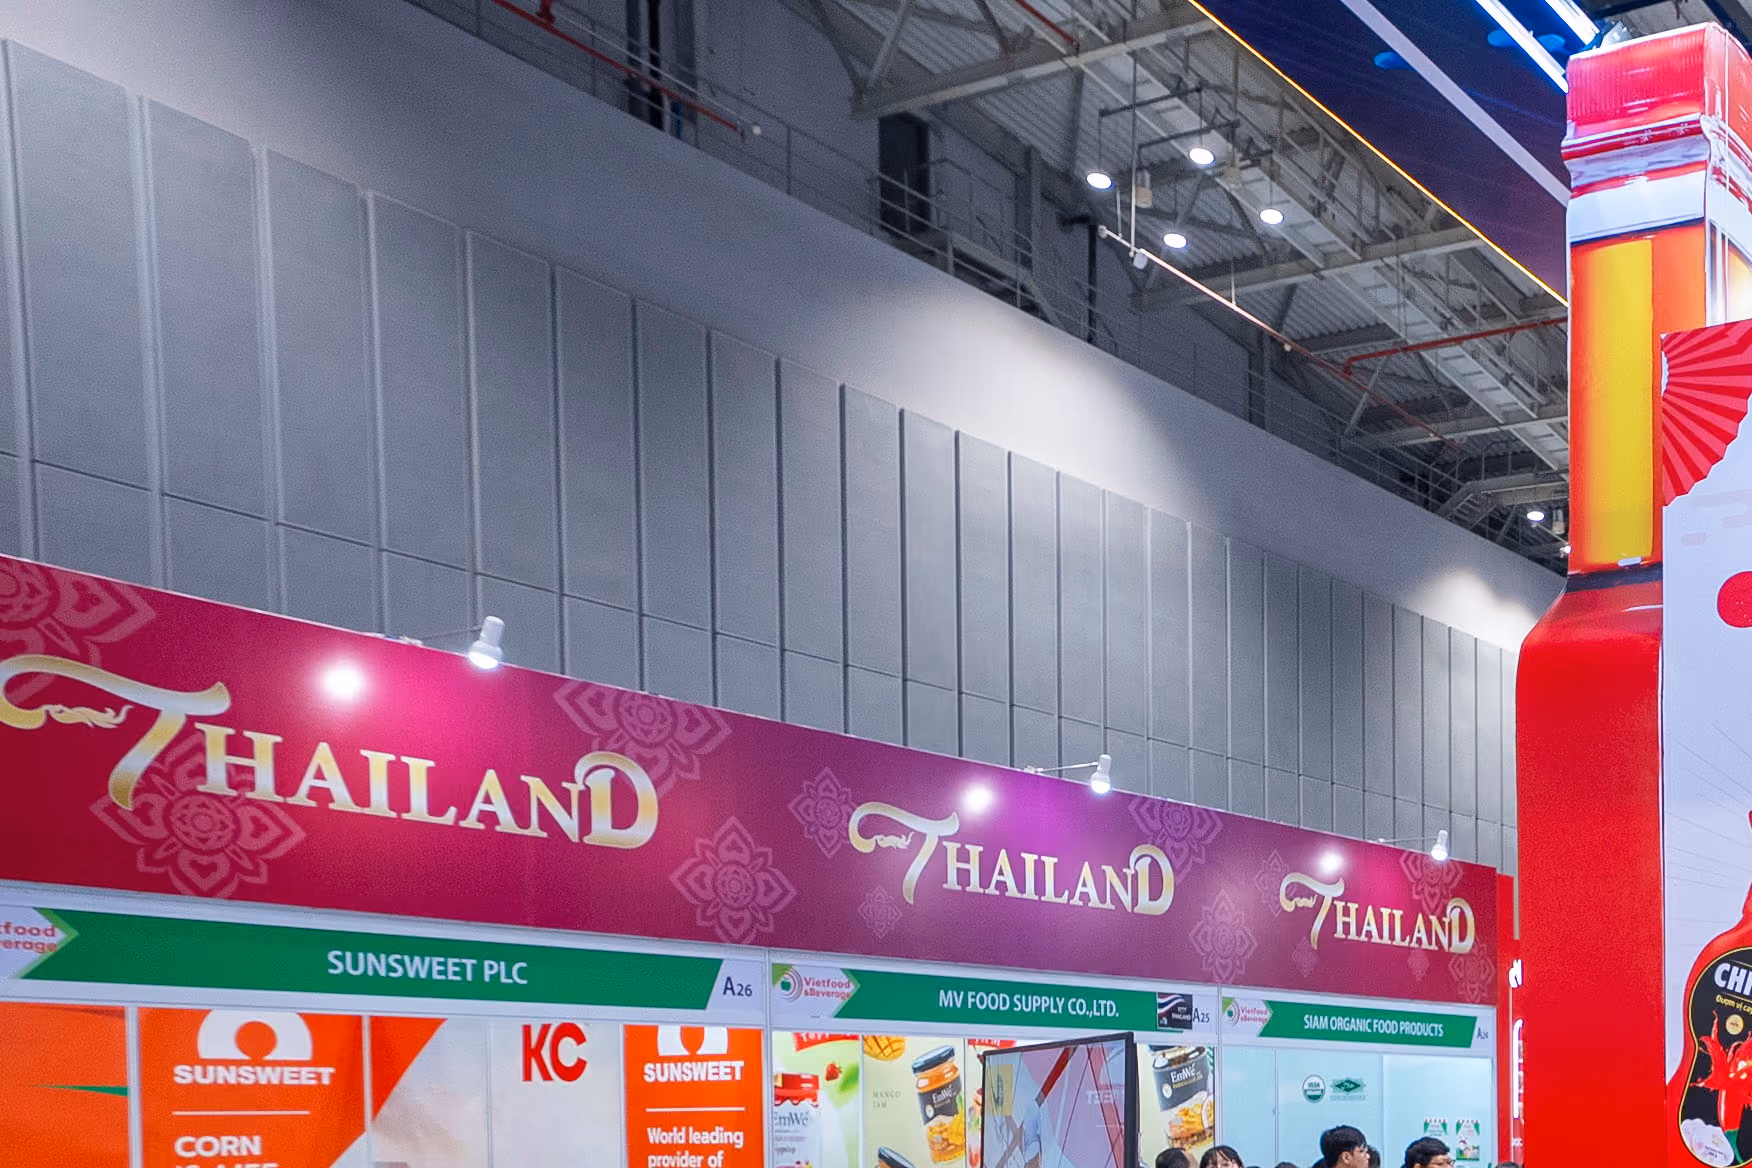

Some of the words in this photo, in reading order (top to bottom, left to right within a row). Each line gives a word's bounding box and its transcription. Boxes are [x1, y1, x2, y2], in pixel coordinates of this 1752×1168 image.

[0, 654, 659, 850] THAILAND
[848, 801, 1175, 917] THAILAND
[1278, 872, 1477, 954] THAILAND
[0, 940, 57, 954] erage
[327, 949, 477, 983] SUNSWEET
[484, 960, 528, 985] PLC
[723, 977, 752, 997] A26
[803, 977, 850, 989] Vietfood
[939, 989, 962, 1008] MV
[966, 990, 1008, 1011] FOOD
[1013, 993, 1065, 1016] SUPPLY
[1068, 998, 1120, 1018] CO.,LTD.
[1193, 1008, 1210, 1023] A25
[1304, 1014, 1328, 1030] SIAM
[1329, 1016, 1371, 1033] ORGANIC
[1373, 1019, 1398, 1034] FOOD
[1400, 1021, 1443, 1037] PRODUCTS
[522, 1022, 588, 1083] KC
[173, 1064, 335, 1086] SUNSWEET
[643, 1060, 744, 1083] SUNSWEET
[174, 1135, 261, 1158] CORN
[647, 1127, 686, 1145] World
[689, 1127, 744, 1150] leading
[707, 1150, 724, 1168] of
